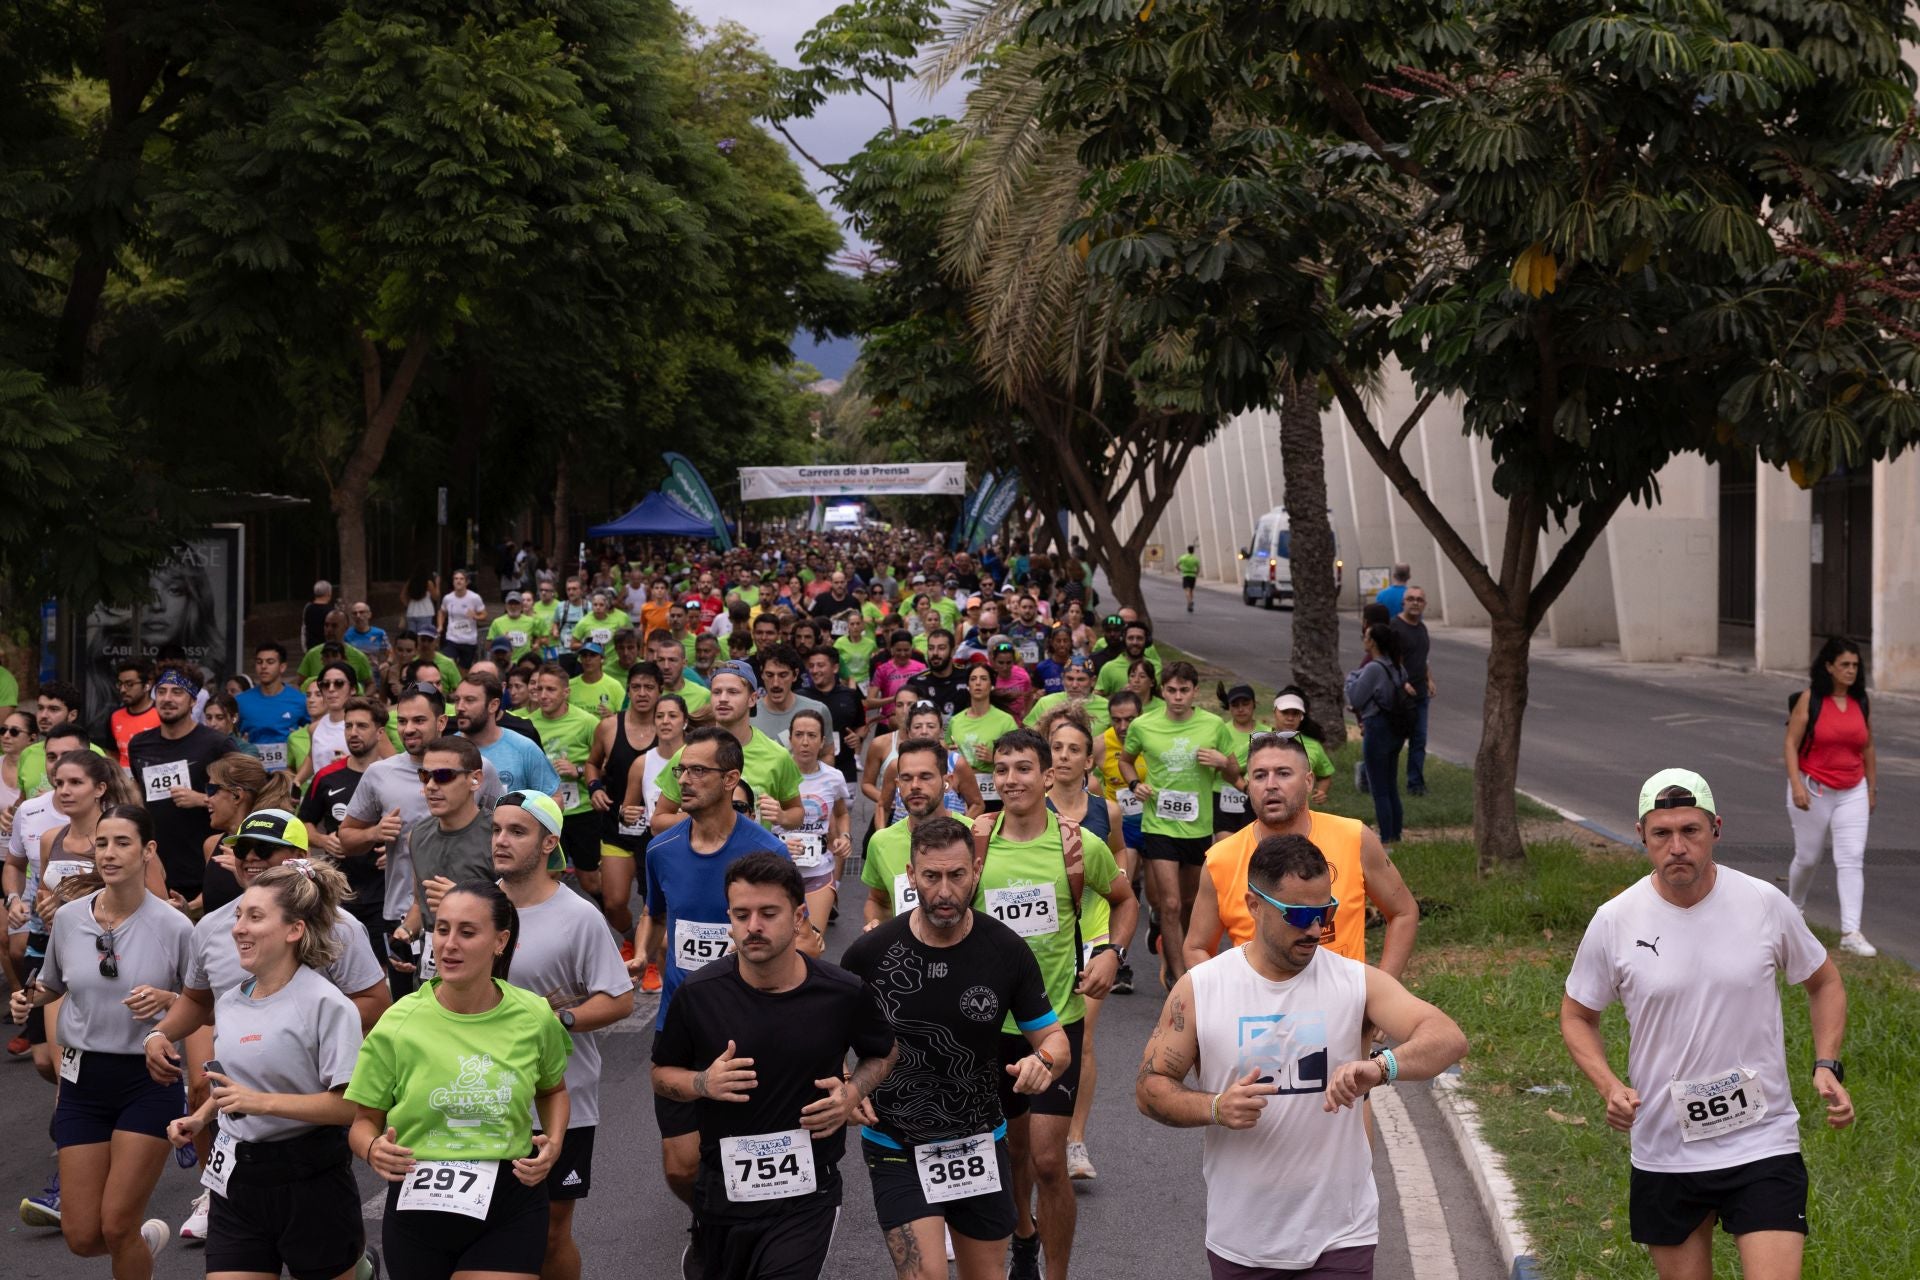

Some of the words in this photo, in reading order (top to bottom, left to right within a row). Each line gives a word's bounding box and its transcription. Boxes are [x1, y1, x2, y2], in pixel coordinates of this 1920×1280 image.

[799, 468, 840, 477] Carrera
[843, 467, 857, 476] de
[860, 467, 870, 476] la
[872, 466, 910, 476] Prensa
[102, 646, 159, 656] CABELO
[259, 751, 283, 761] 558
[151, 774, 182, 789] 481
[1163, 800, 1192, 812] 586
[993, 901, 1049, 921] 1073
[683, 939, 729, 957] 457
[1686, 1088, 1748, 1122] 861
[735, 1154, 800, 1182] 754
[928, 1156, 986, 1185] 368
[413, 1168, 478, 1193] 297
